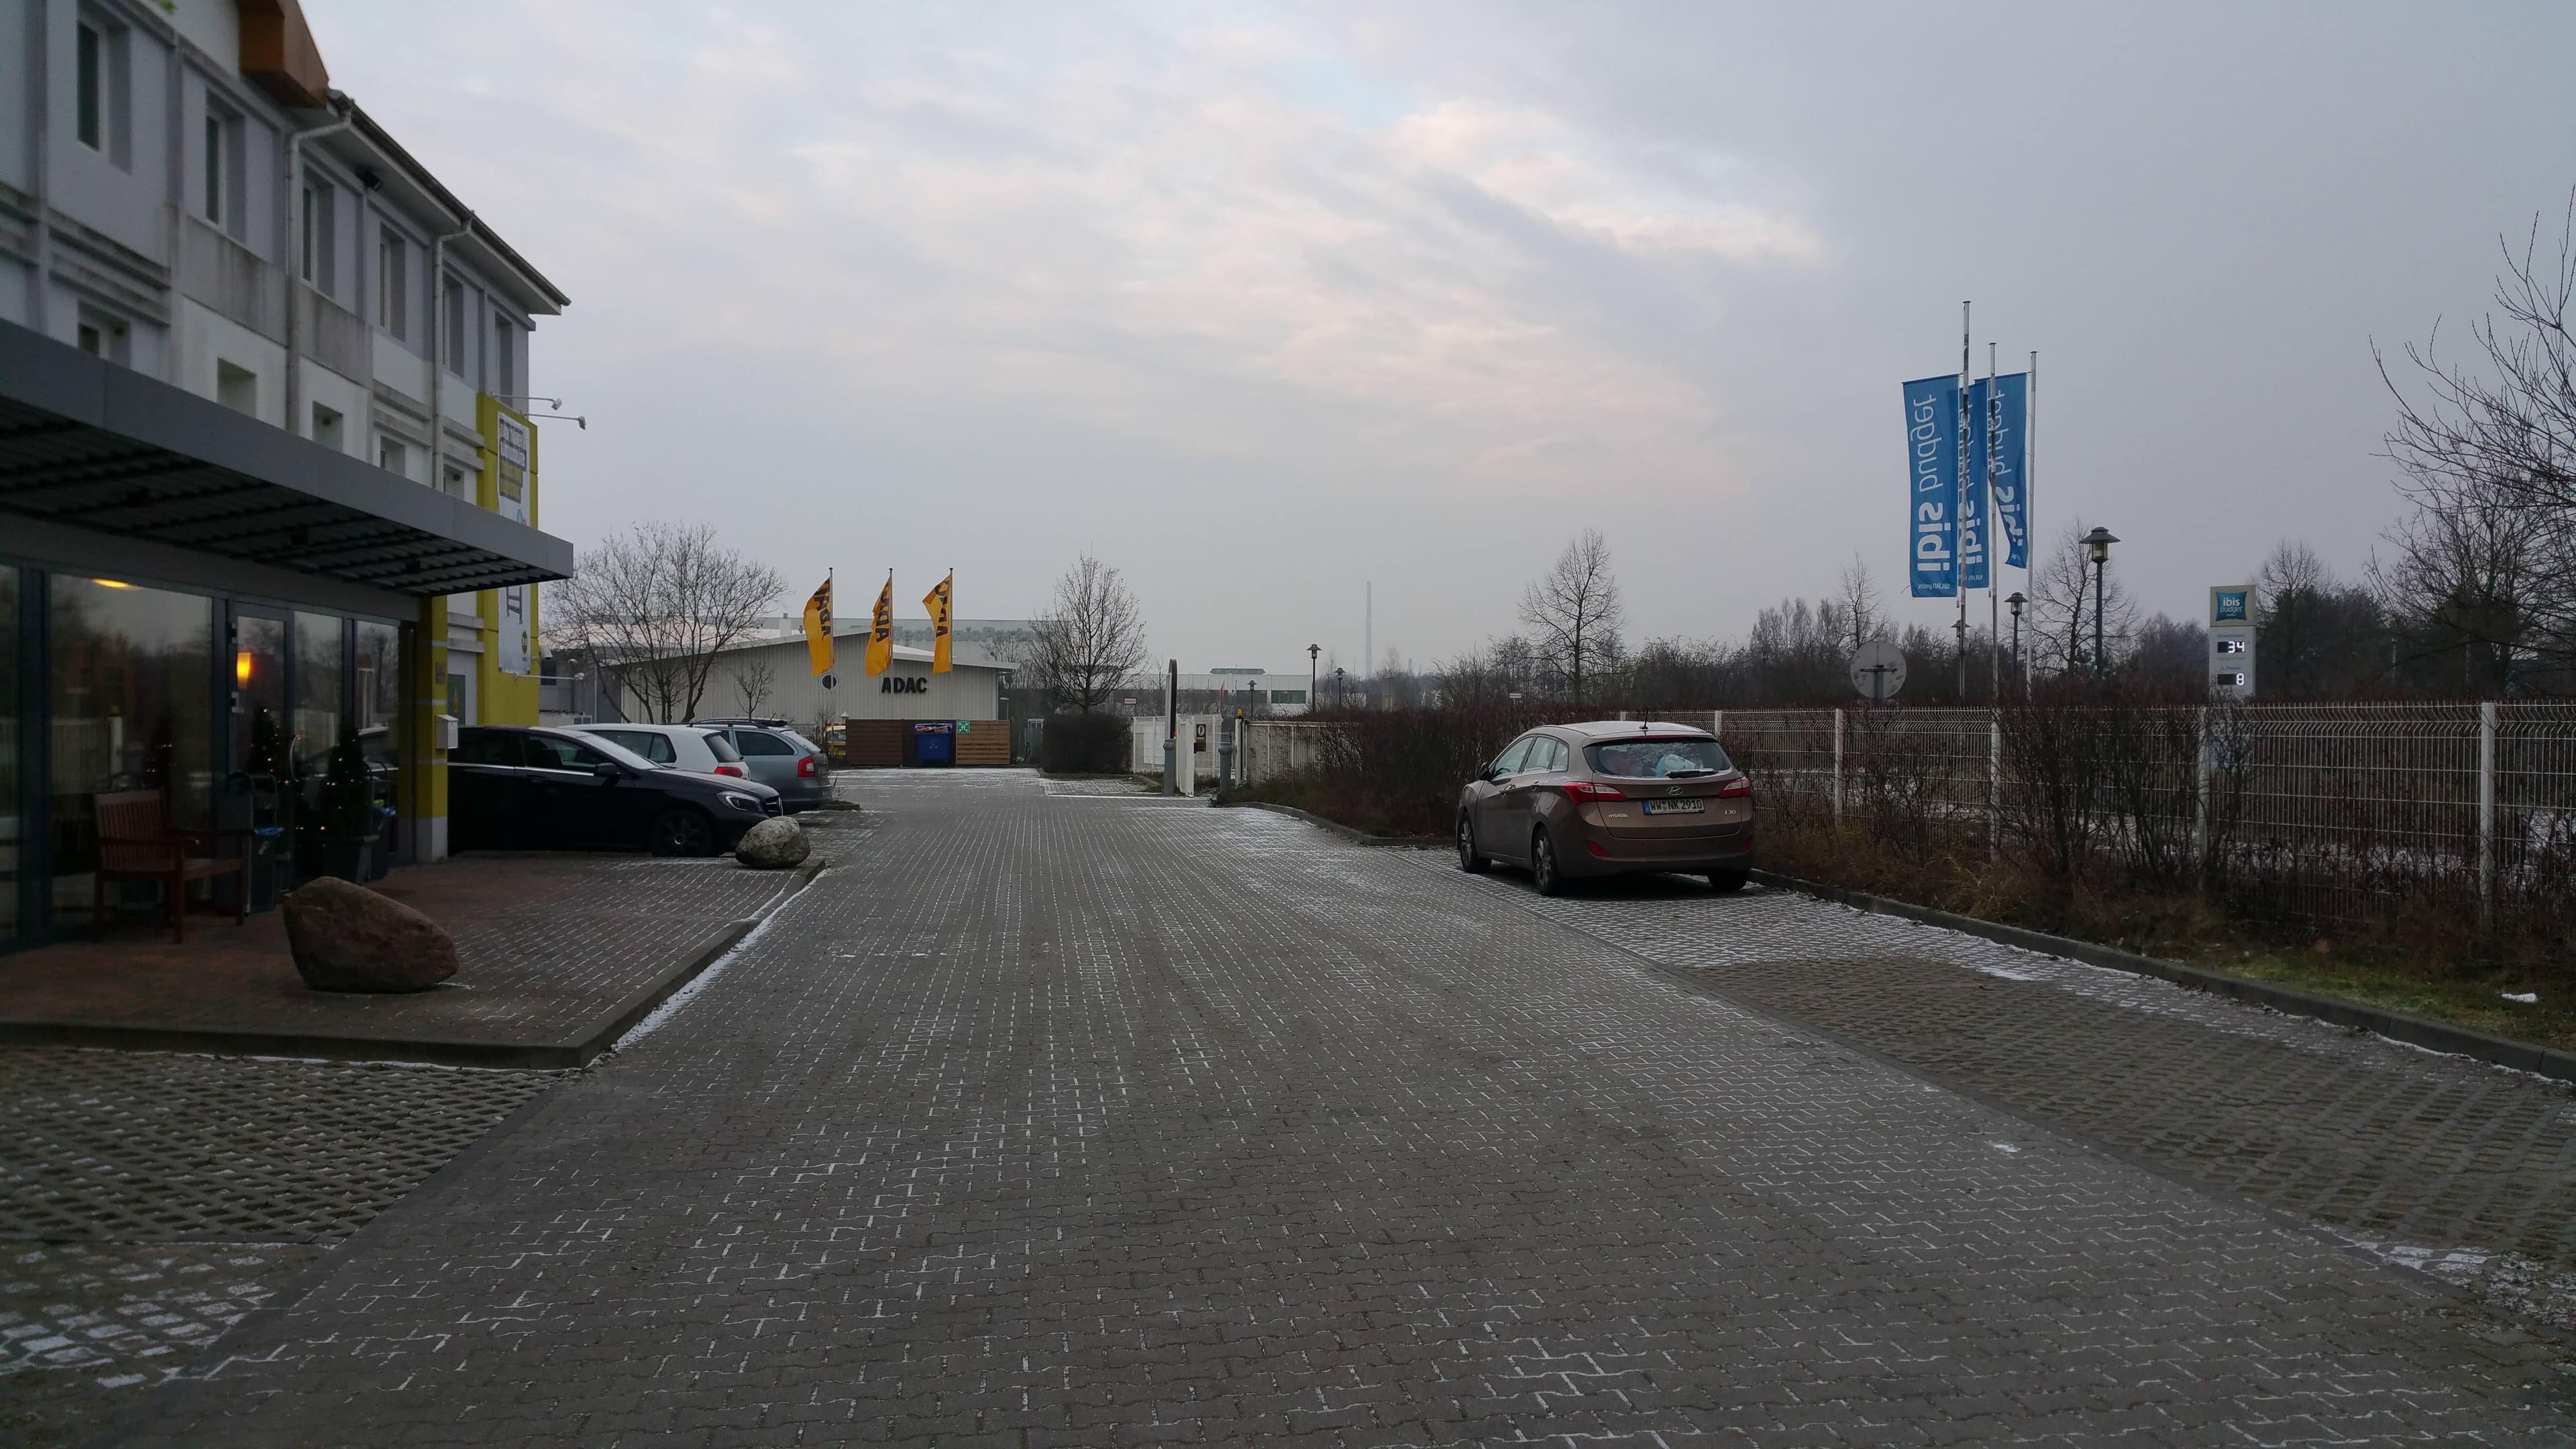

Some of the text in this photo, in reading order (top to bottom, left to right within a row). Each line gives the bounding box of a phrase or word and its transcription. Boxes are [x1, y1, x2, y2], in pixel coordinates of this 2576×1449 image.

[2223, 597, 2241, 606] ibis
[2228, 641, 2245, 653] 34
[881, 677, 928, 694] ADAC
[2237, 673, 2245, 686] 8
